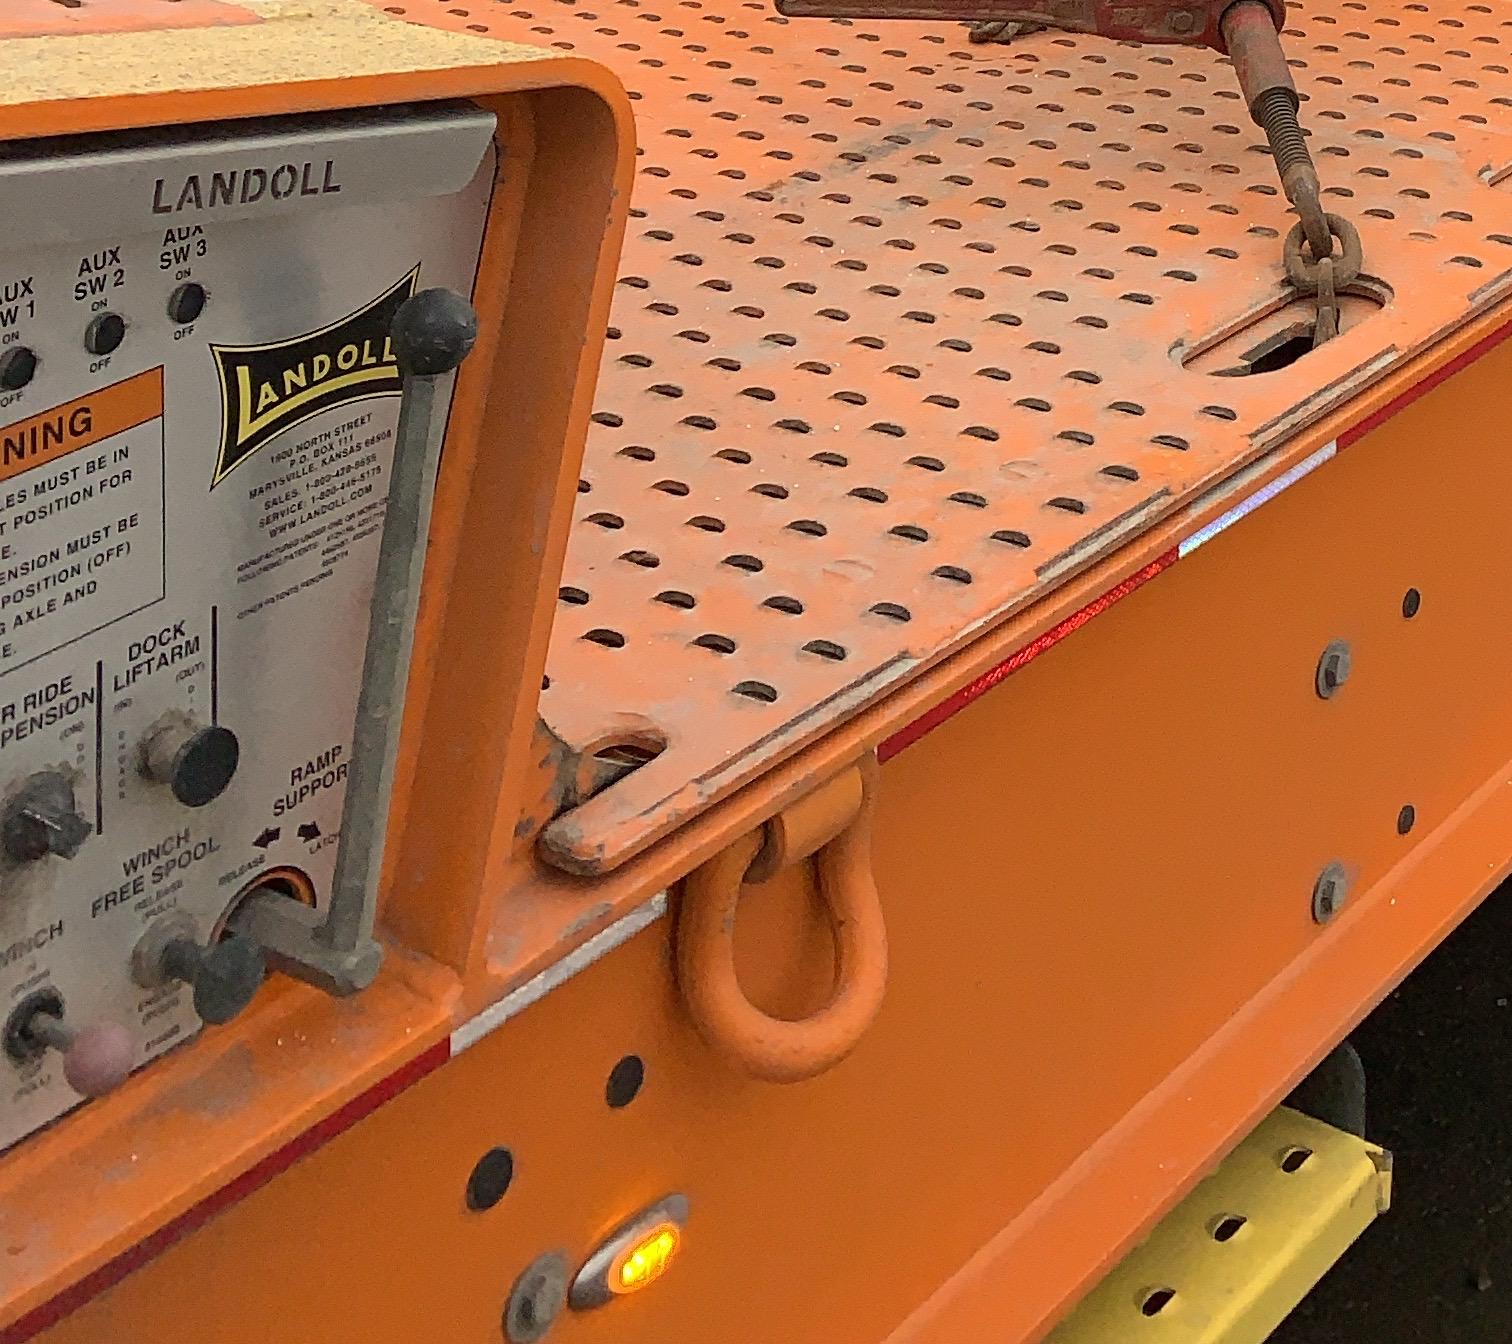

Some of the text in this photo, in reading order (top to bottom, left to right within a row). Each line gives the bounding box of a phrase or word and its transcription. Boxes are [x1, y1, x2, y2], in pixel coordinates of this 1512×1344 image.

[151, 160, 342, 214] LANDOLL
[77, 245, 121, 277] AUX
[159, 238, 208, 270] SW 3
[175, 267, 192, 281] ON
[74, 268, 125, 301] SW 2
[91, 298, 108, 312] ON
[26, 300, 36, 319] 1
[2, 330, 20, 345] ON
[173, 325, 195, 341] OFF
[89, 356, 112, 374] OFF
[0, 390, 24, 409] OFF
[236, 336, 399, 447] LANDOLL
[3, 406, 93, 466] NING
[296, 432, 331, 456] NORTH
[333, 413, 373, 437] STREET
[313, 443, 335, 459] BOX
[338, 433, 354, 447] 111
[321, 442, 363, 468] KANSAS
[34, 466, 80, 497] MUST
[86, 455, 108, 475] BE
[113, 445, 129, 464] IN
[14, 485, 94, 530] POSITION
[99, 469, 133, 494] FOR
[0, 513, 140, 587] ENSION MUST BE
[1, 541, 132, 610] POSITION (OFF)
[13, 597, 57, 630] AXLE
[63, 579, 98, 607] AND
[128, 619, 187, 663] DOCK
[113, 635, 200, 693] LIFTARM
[23, 675, 73, 714] RIDE
[0, 686, 95, 750] PENSION
[290, 745, 343, 787] RAMP
[273, 762, 348, 818] SUPPOR
[122, 827, 191, 879] WINCH
[91, 836, 222, 919] FREE SPOOL
